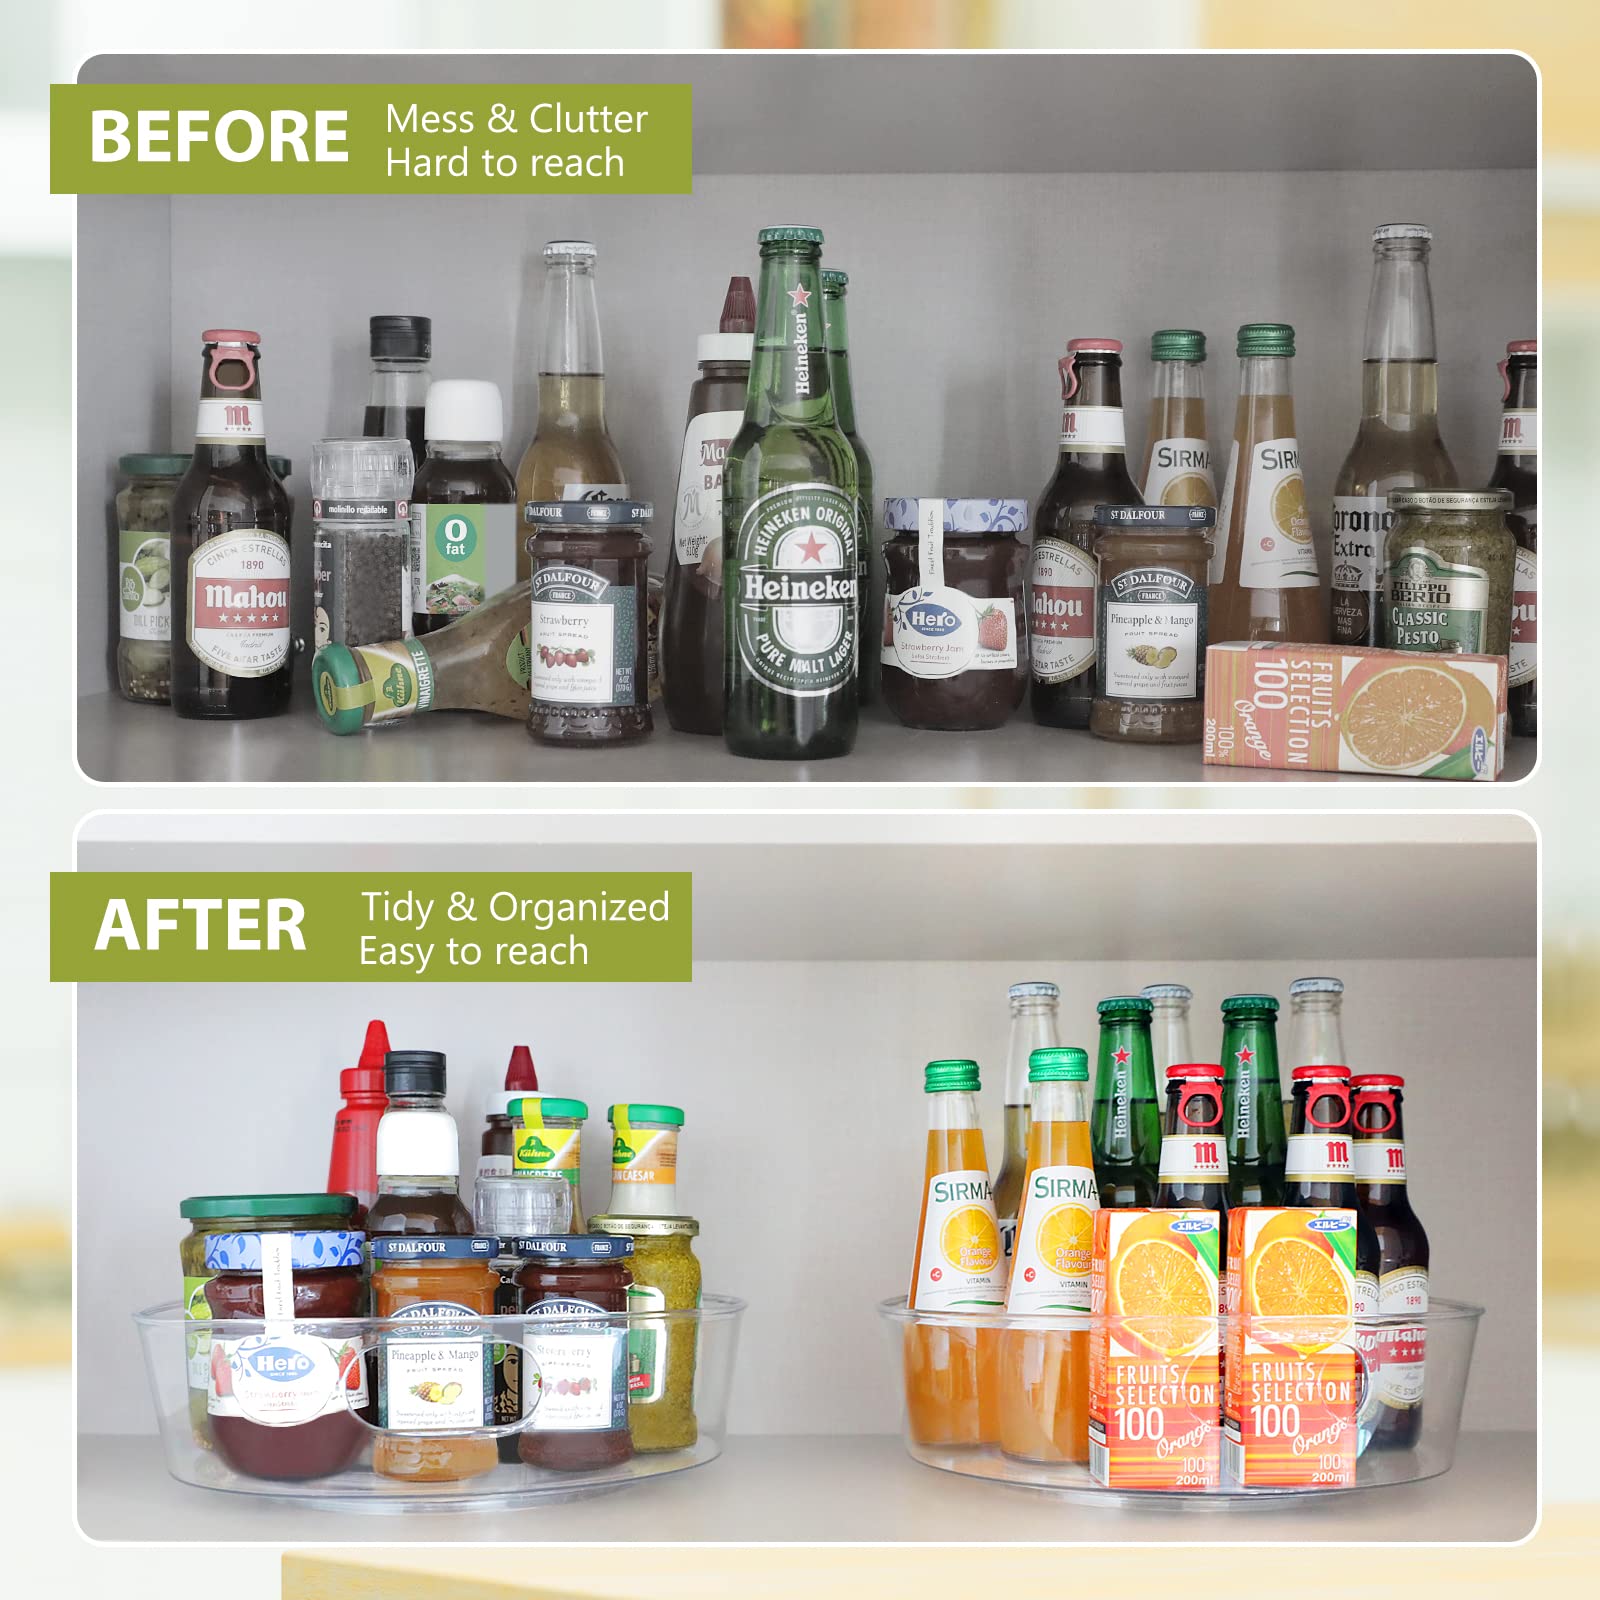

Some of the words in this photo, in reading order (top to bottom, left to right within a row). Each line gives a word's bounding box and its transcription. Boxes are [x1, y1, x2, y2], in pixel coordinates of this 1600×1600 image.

[793, 313, 809, 395] Heineken
[328, 505, 355, 514] molinillo
[1120, 510, 1166, 521] DALFOUR
[754, 506, 811, 557] HEINEKEN
[815, 506, 855, 556] ORIGINAL
[242, 543, 287, 567] ESTRELLAS
[446, 543, 466, 555] fat
[1334, 535, 1375, 558] Extra
[240, 560, 264, 570] 1890
[1038, 551, 1083, 577] ESTRELLAS
[1038, 567, 1053, 577] 1890
[543, 571, 600, 592] DALFOUR
[745, 574, 856, 602] Heineken
[1130, 573, 1188, 592] DALFOUR
[204, 584, 287, 609] Mahou
[1032, 592, 1084, 617] ahou
[1141, 592, 1164, 600] FRANCE
[1391, 589, 1451, 604] BERIO
[150, 615, 170, 628] PICK
[540, 614, 590, 629] Strawberry
[911, 611, 956, 627] Hero
[1111, 613, 1153, 627] Pineapple
[1154, 616, 1162, 625] &
[1397, 627, 1440, 645] PESTO
[756, 633, 786, 668] PURE
[788, 658, 825, 674] MALT
[828, 630, 854, 668] LAGER
[901, 641, 944, 653] Strawberry
[946, 645, 964, 653] Jam
[1253, 658, 1289, 710] 100
[1311, 662, 1333, 729] FRUITS
[1287, 659, 1312, 764] SELECTION
[1204, 717, 1217, 758] 200ml
[1233, 699, 1272, 761] Orange
[1218, 725, 1235, 758] 100%
[1114, 1070, 1127, 1139] Heineken
[1237, 1069, 1250, 1139] Heineken
[518, 1149, 551, 1158] Kühne
[614, 1150, 633, 1158] ühne
[624, 1169, 655, 1181] CAESAR
[399, 1243, 446, 1252] DALFOUR
[525, 1241, 567, 1252] DALFOUR
[1055, 1247, 1092, 1261] Orange
[1406, 1296, 1421, 1305] 1890
[257, 1356, 309, 1371] Hero
[392, 1350, 436, 1363] Pineapple
[438, 1351, 445, 1360] &
[448, 1350, 479, 1361] Mango
[1117, 1365, 1180, 1385] FRUITS
[1252, 1362, 1316, 1382] FRUITS
[1115, 1384, 1215, 1406] SELECTION
[1251, 1381, 1350, 1403] SELECTION
[1115, 1407, 1164, 1440] 100
[1250, 1404, 1300, 1437] 100
[1156, 1420, 1212, 1459] Orange
[1292, 1417, 1348, 1456] Orange
[1176, 1476, 1213, 1485] 200ml
[1312, 1472, 1349, 1483] 200ml
